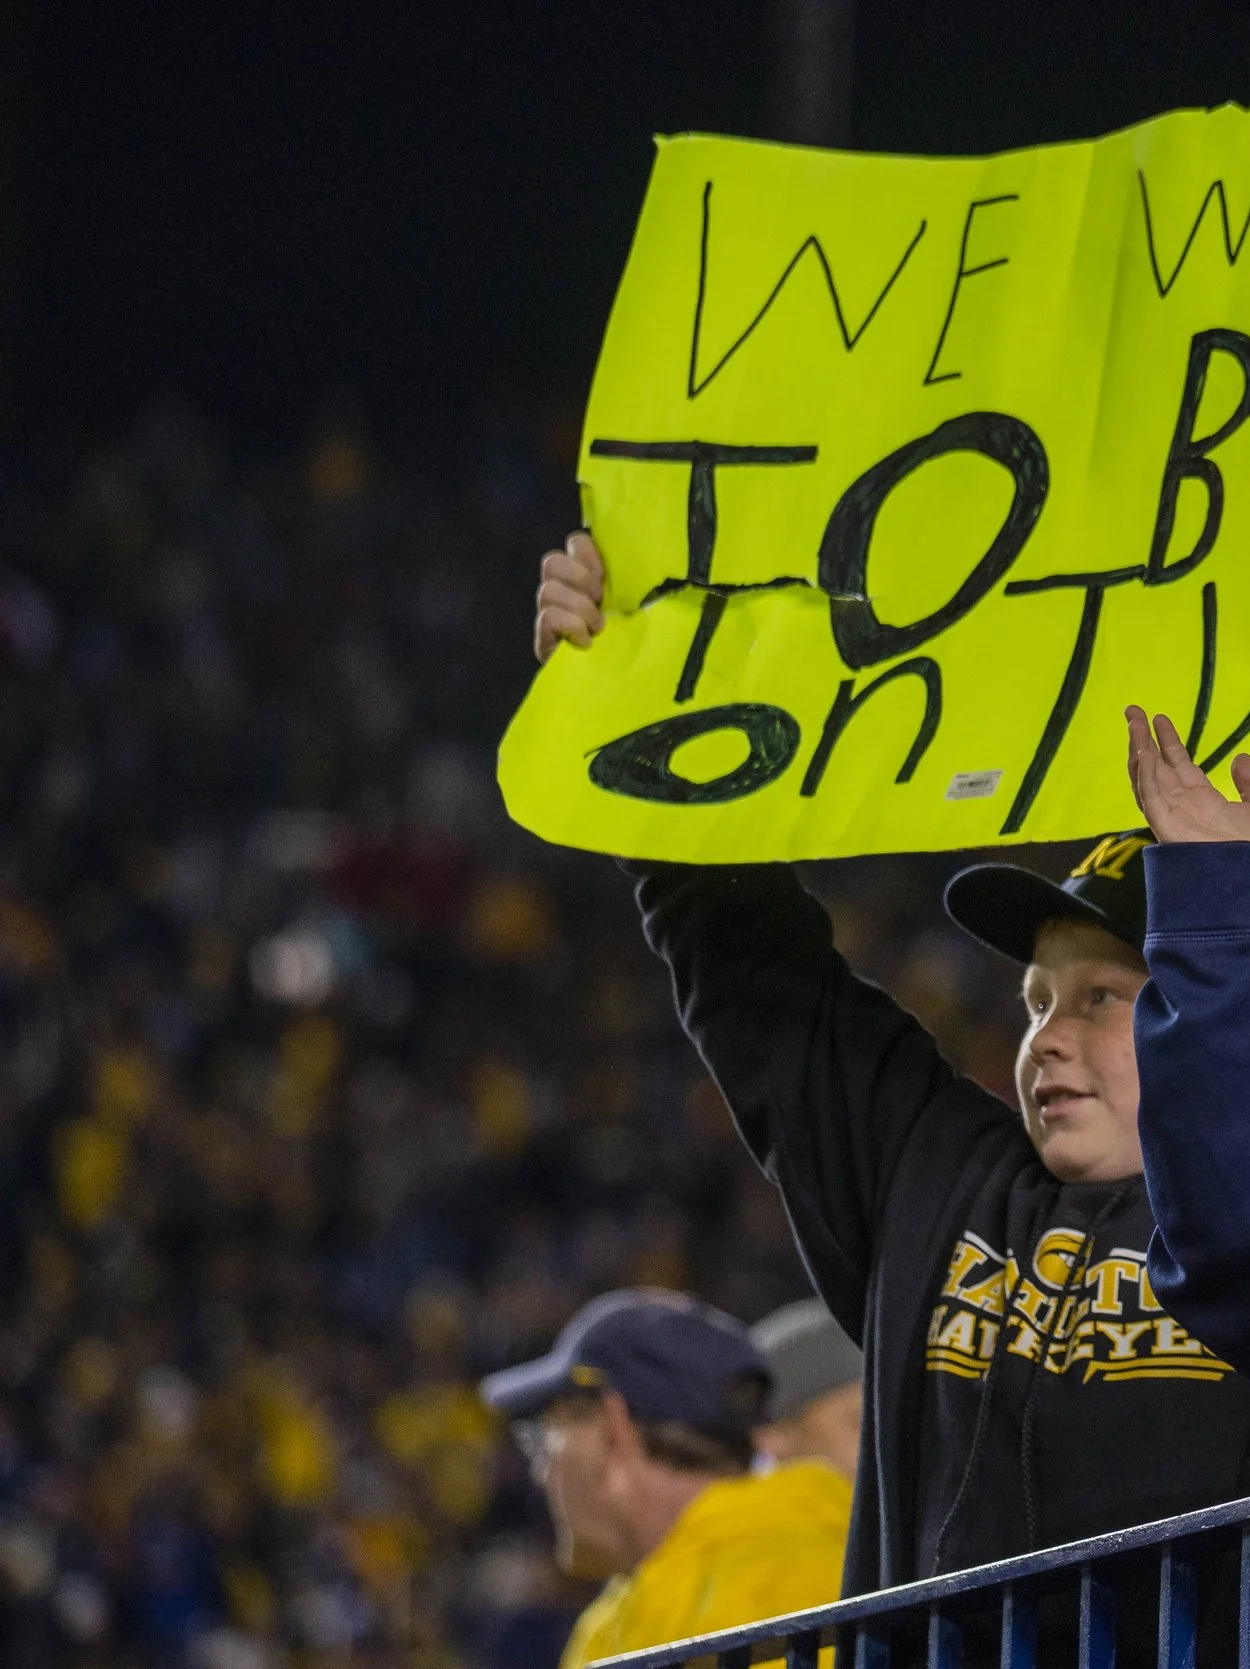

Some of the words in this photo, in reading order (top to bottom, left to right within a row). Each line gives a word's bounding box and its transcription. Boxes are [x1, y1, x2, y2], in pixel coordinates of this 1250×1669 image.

[688, 180, 1019, 400] WE
[589, 411, 1050, 704] TO
[584, 655, 943, 806] on
